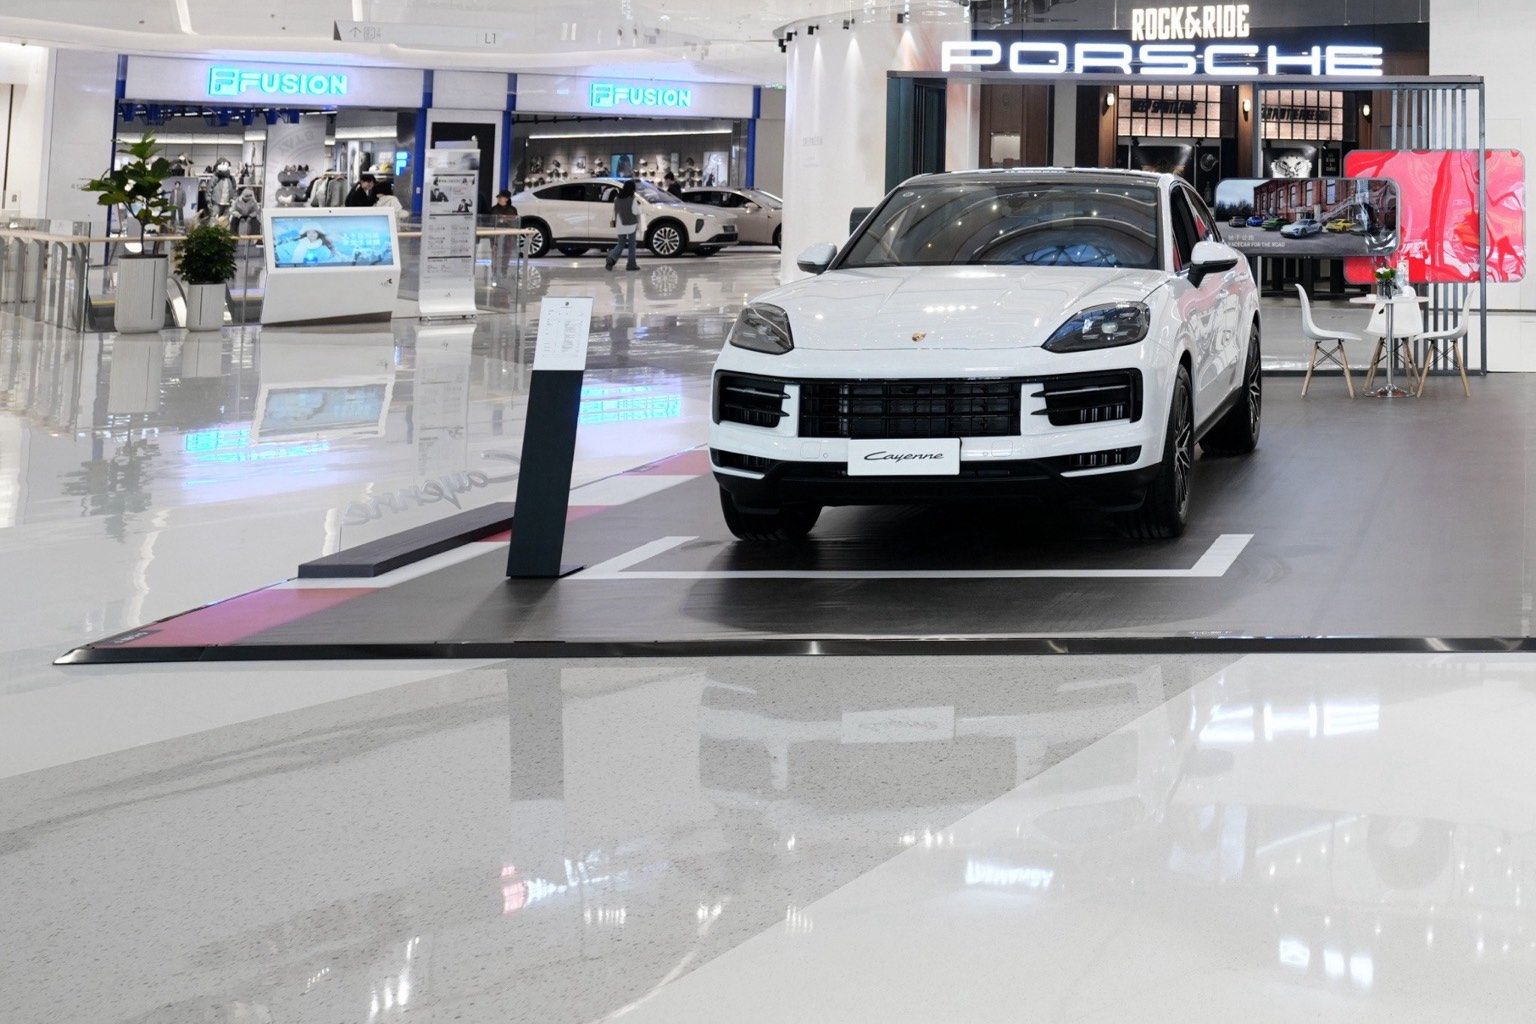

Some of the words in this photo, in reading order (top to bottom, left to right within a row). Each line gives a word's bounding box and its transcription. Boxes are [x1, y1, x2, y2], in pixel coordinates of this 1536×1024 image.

[1131, 4, 1251, 41] ROCK&RIDE
[484, 32, 497, 45] L1
[941, 40, 1384, 76] PORSCHE
[240, 72, 348, 95] FUSION
[614, 87, 692, 107] FUSION
[863, 451, 945, 463] Cayenne
